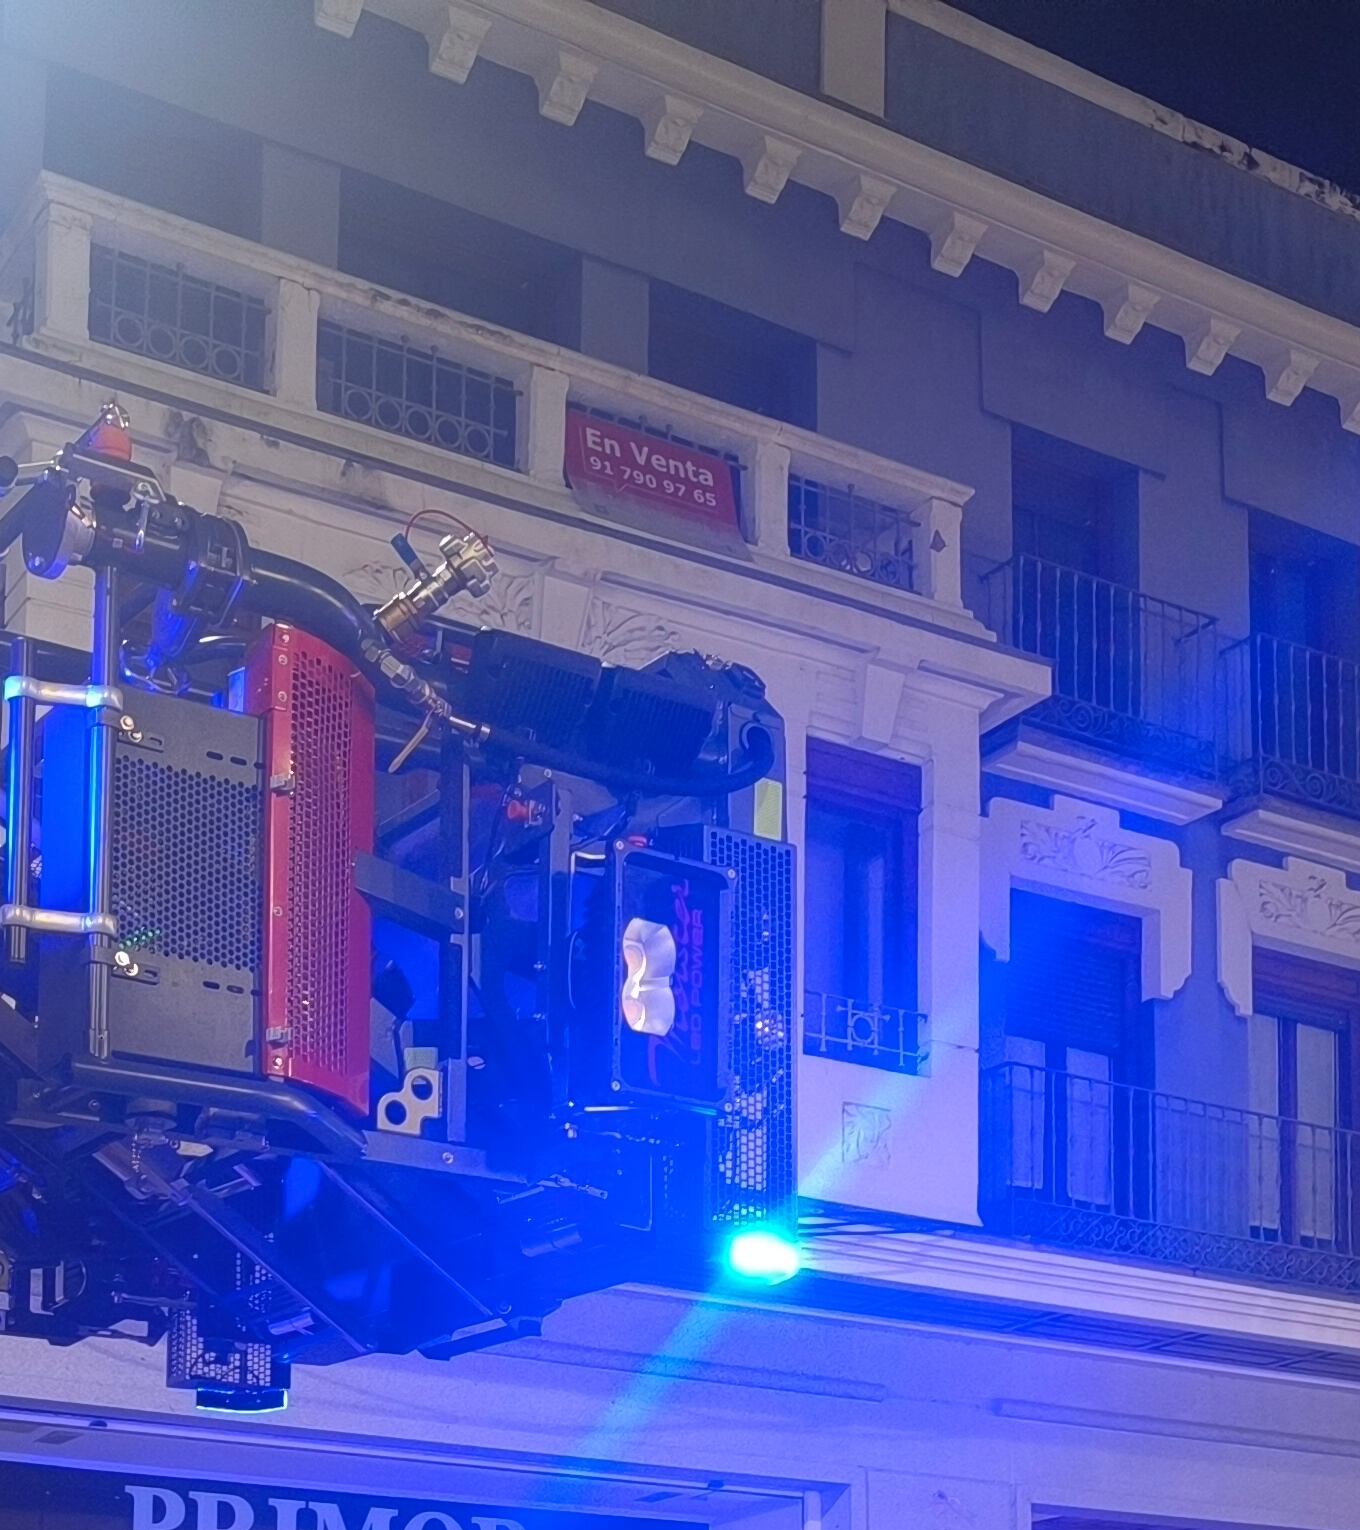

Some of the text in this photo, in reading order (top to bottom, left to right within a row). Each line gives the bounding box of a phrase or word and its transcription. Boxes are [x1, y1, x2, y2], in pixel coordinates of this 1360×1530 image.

[585, 427, 714, 487] En Venta
[589, 456, 717, 507] 91 790 97 65
